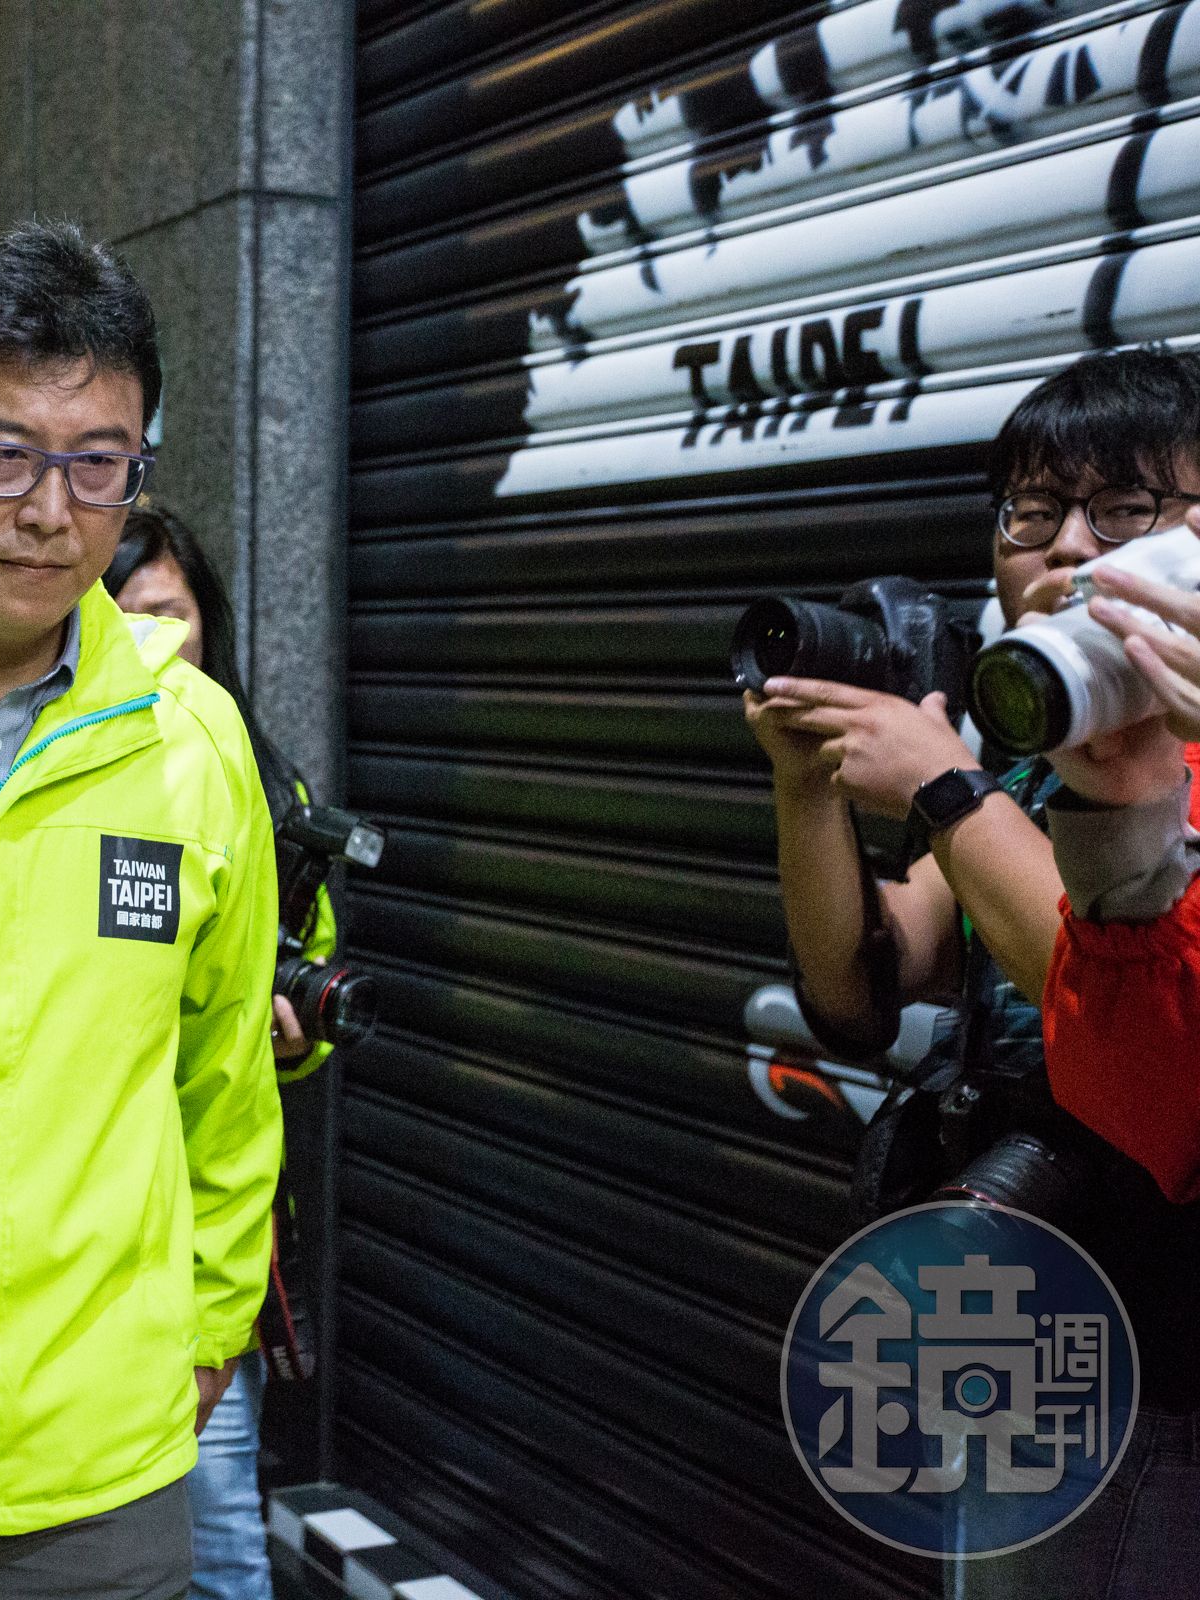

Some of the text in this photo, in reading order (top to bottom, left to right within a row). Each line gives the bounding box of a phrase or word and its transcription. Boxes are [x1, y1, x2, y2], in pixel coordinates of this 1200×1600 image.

[673, 298, 932, 449] TAIPEI
[113, 858, 166, 880] TAIWAN
[107, 877, 173, 911] TAIPEI
[116, 910, 163, 930] 國家首都
